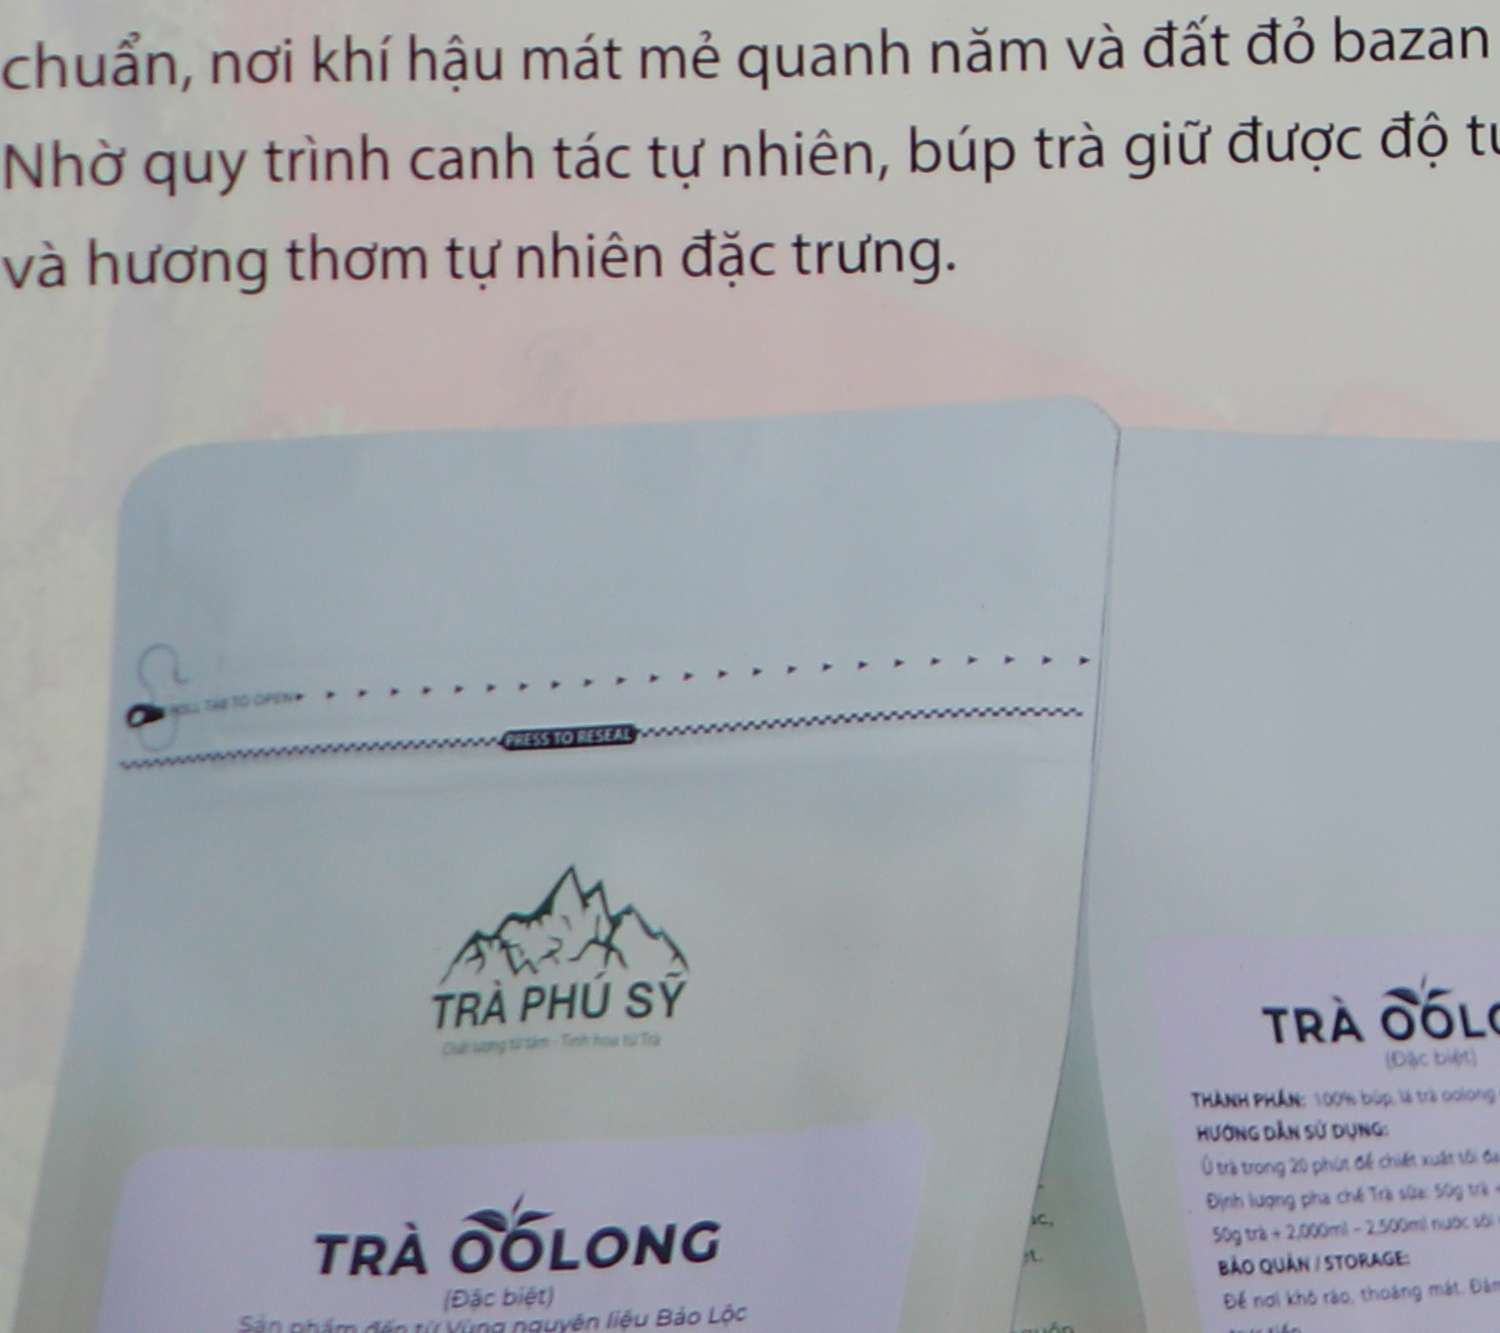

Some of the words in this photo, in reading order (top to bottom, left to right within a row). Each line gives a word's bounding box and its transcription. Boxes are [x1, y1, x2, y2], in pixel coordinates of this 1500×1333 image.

[505, 732, 551, 748] PRESS
[554, 730, 574, 746] TO
[576, 727, 633, 745] RESEAL
[431, 979, 507, 1030] TRÀ
[518, 972, 611, 1022] PHÚ
[625, 970, 688, 1021] SỸ
[1262, 996, 1365, 1044] TRÀ
[1192, 1090, 1250, 1109] THÀNH
[314, 1222, 429, 1277] TRÀ
[451, 1220, 722, 1274] OOLONG
[444, 1288, 497, 1312] (Đặc
[502, 1286, 553, 1310] biệt)
[656, 1306, 702, 1329] Bảo
[708, 1303, 748, 1328] Lộc
